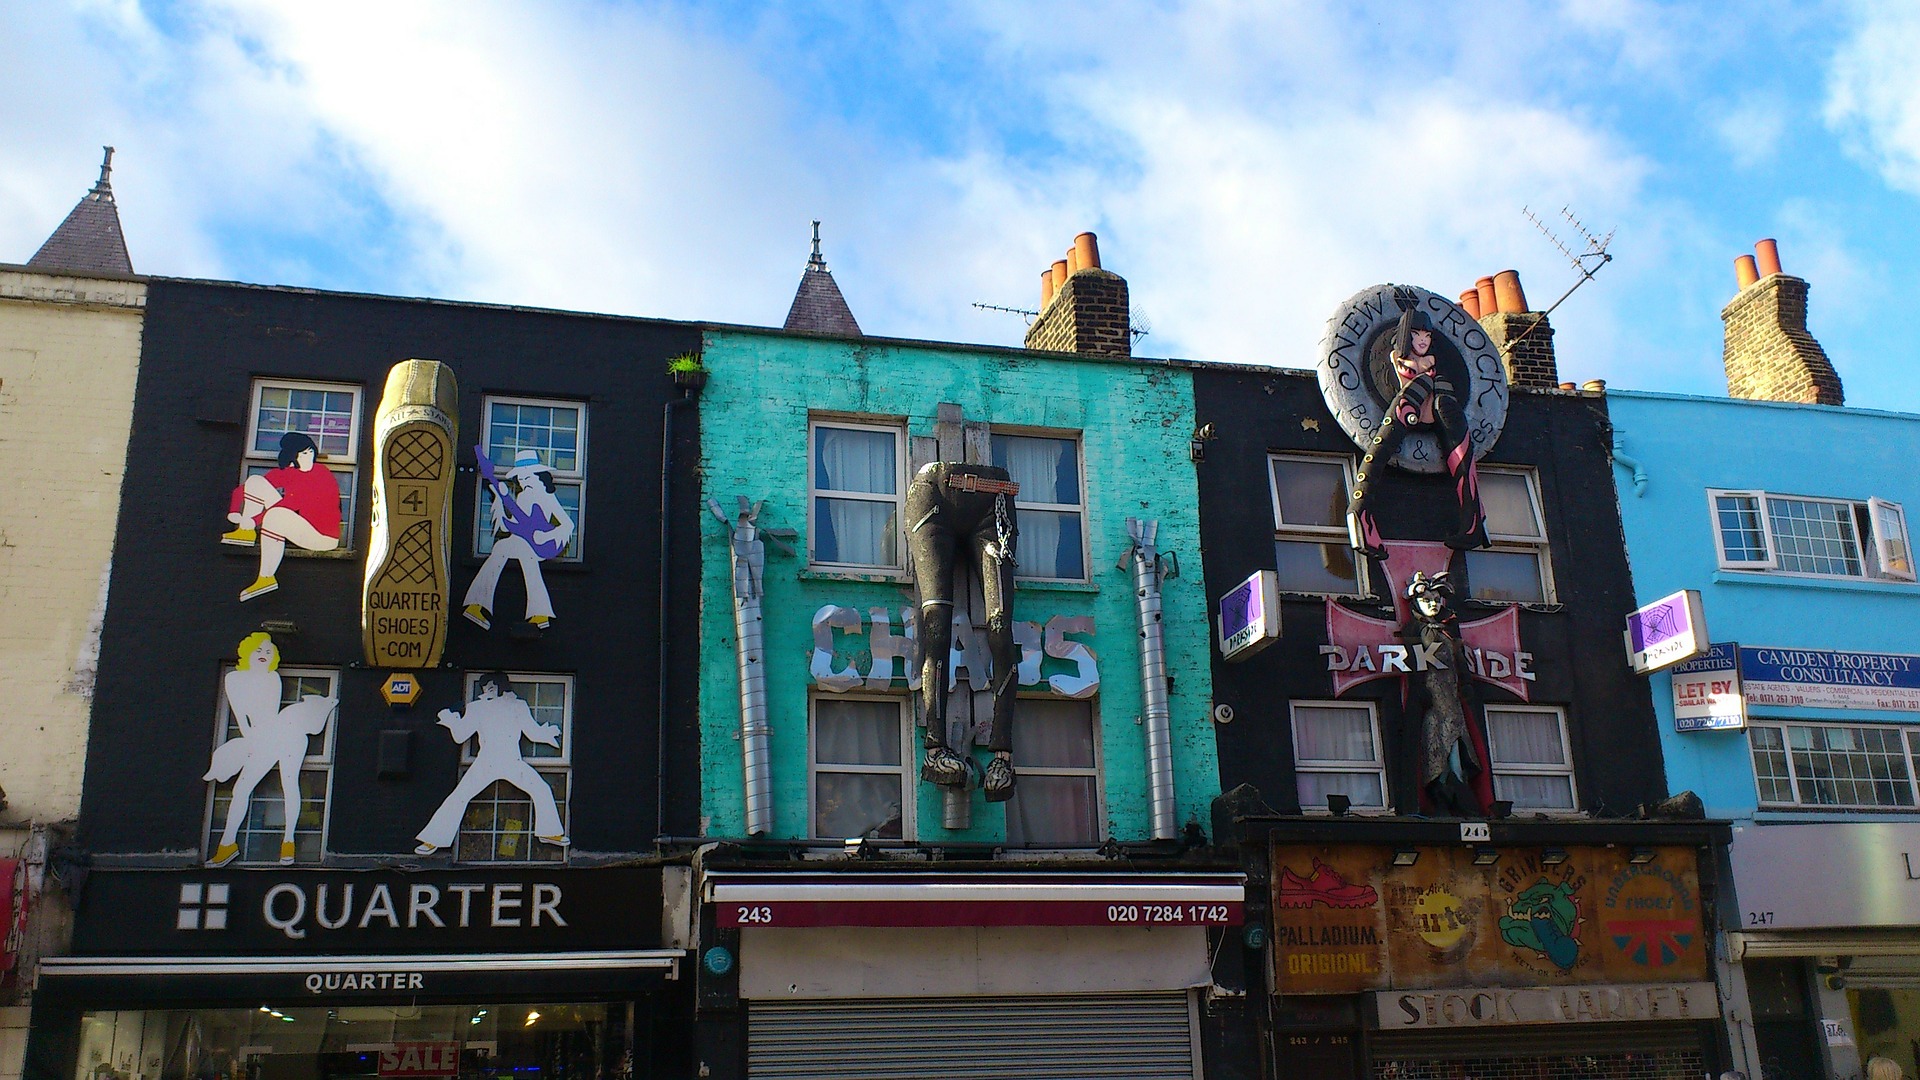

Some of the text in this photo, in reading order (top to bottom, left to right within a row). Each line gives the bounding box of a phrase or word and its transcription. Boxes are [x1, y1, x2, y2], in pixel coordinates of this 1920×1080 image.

[1328, 291, 1502, 408] NEW ROCK
[1413, 440, 1429, 462] &
[402, 489, 423, 511] 4
[369, 591, 441, 611] QUARTER
[377, 617, 429, 636] SHOES
[1319, 641, 1449, 673] DARK
[1674, 658, 1733, 673] PROPERTIES
[1757, 650, 1911, 672] CAMDEN PROPERTY
[1780, 667, 1895, 686] CONSULTANCY
[391, 683, 411, 692] ADT
[1678, 680, 1732, 699] LET BY
[1767, 684, 1791, 692] AGENTS
[1760, 694, 1774, 702] 0171
[1777, 694, 1788, 703] 267
[1680, 718, 1695, 728] 020
[262, 882, 569, 939] QUARTER
[737, 907, 772, 923] 243
[1107, 906, 1228, 921] 020 7284 1742
[1750, 912, 1774, 925] 247
[305, 973, 424, 994] QUARTER
[1398, 991, 1522, 1026] STOCK
[381, 1045, 456, 1071] SALE
